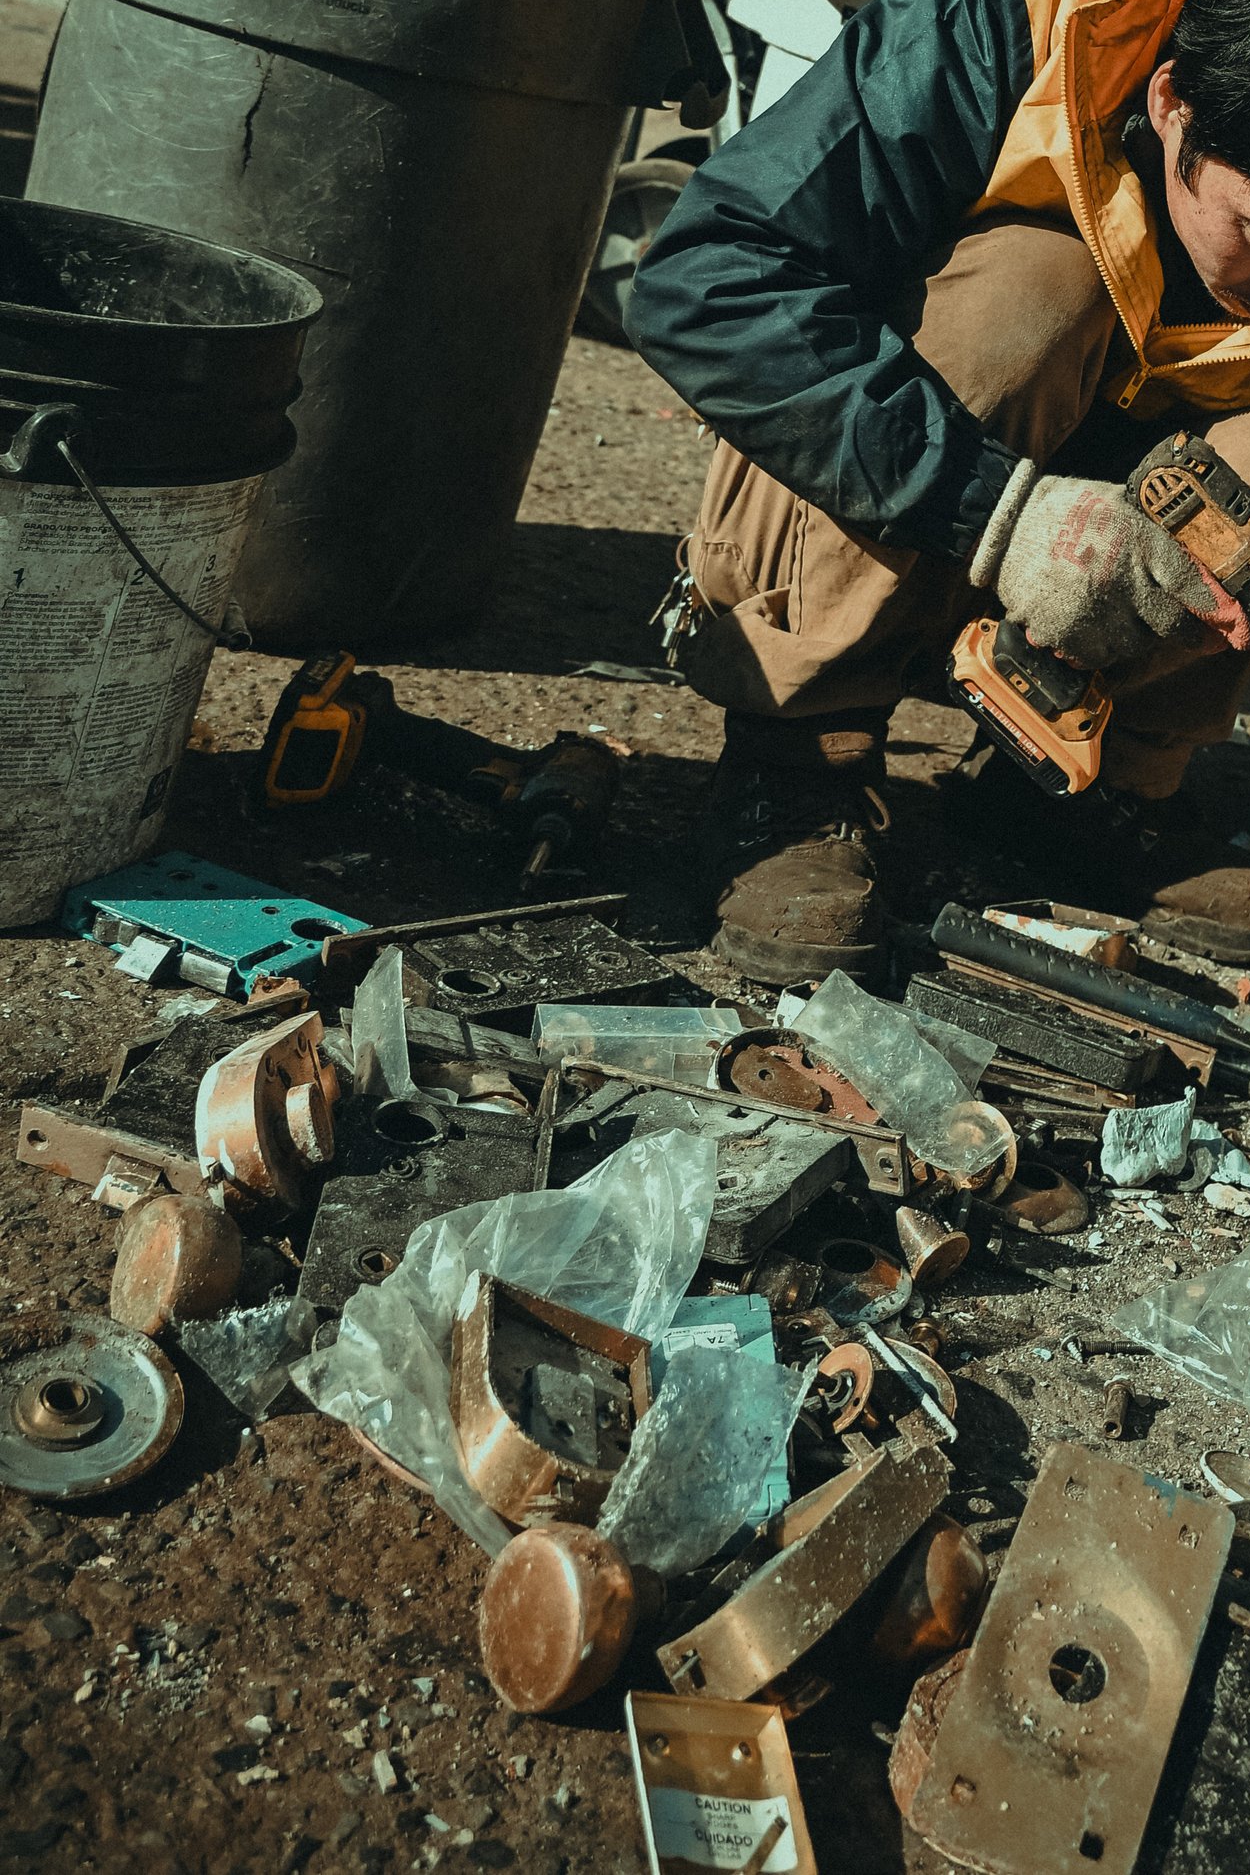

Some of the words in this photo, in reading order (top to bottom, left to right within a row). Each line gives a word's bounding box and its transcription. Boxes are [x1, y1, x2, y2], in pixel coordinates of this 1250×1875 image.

[205, 554, 217, 572] 3
[988, 705, 1023, 739] LITHIUM
[1022, 739, 1040, 755] ION
[695, 1796, 752, 1815] CAUTION
[694, 1828, 753, 1847] CUIDADO
